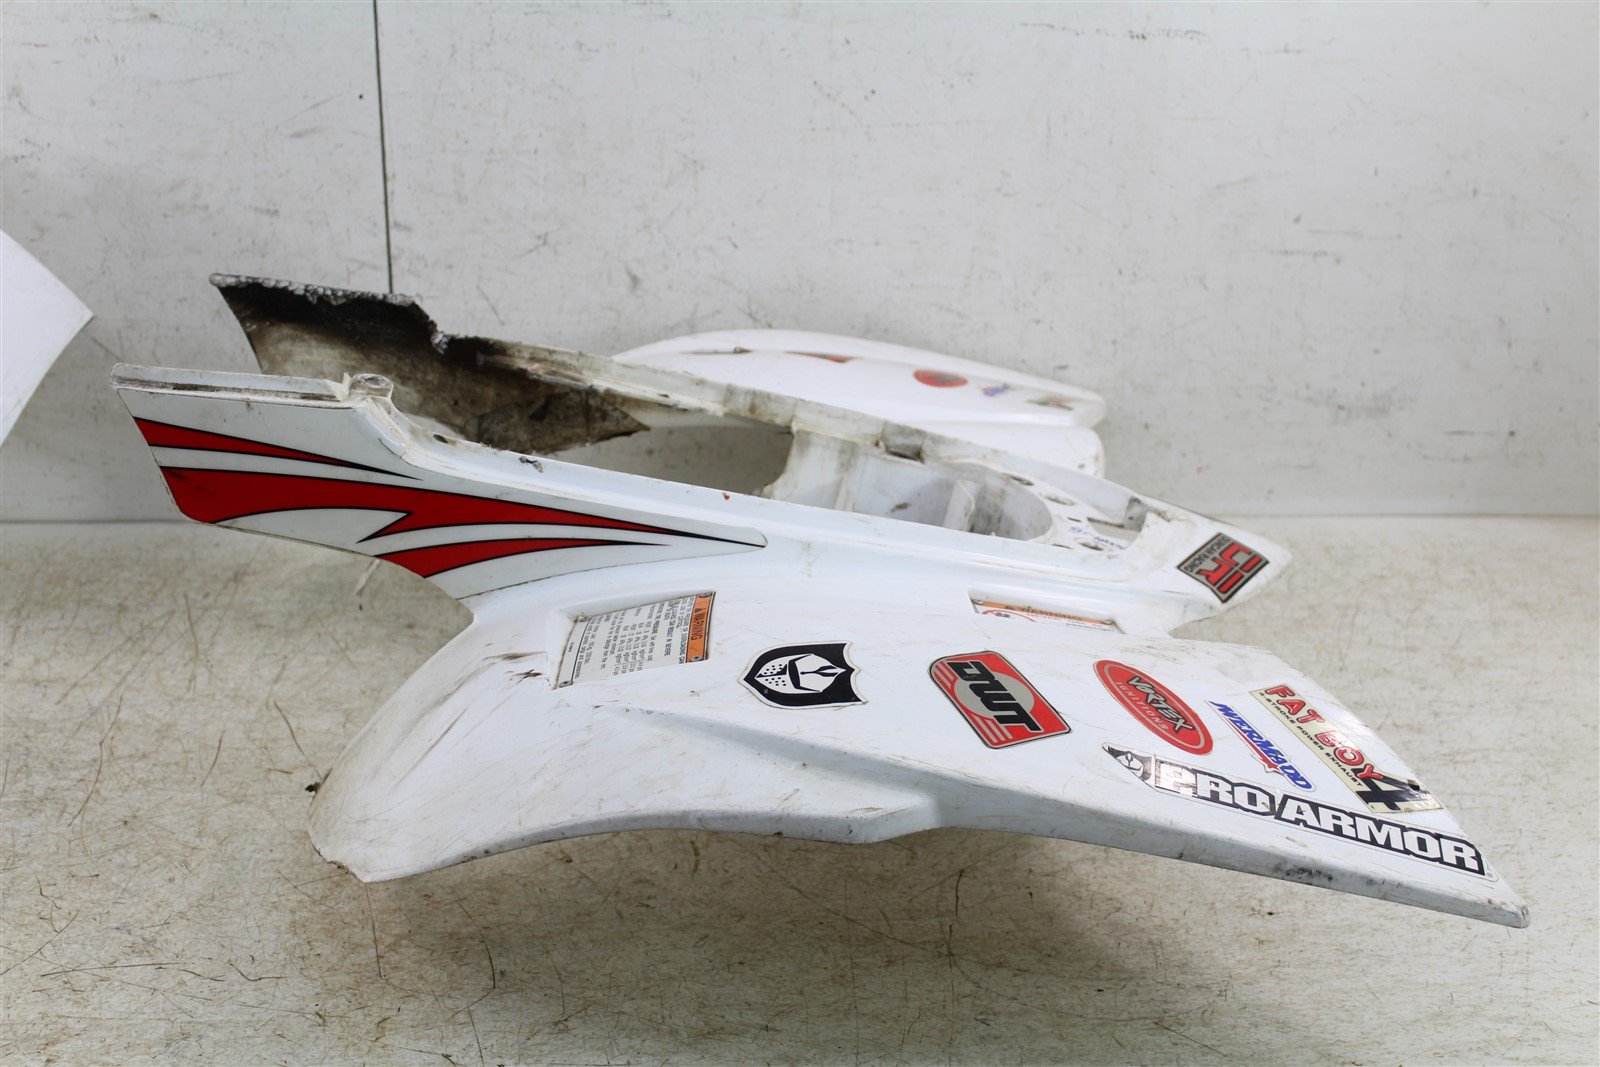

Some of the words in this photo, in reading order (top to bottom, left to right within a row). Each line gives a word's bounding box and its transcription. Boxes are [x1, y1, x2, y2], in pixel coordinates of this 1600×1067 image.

[690, 613, 704, 640] WARNING
[947, 661, 1043, 731] DWT
[1115, 681, 1169, 731] IGNITIONS
[1127, 675, 1196, 733] VORTEX
[1265, 684, 1326, 724] FAT
[1314, 730, 1384, 780] BOY
[1296, 725, 1325, 751] POWER
[1324, 752, 1364, 787] EXHAUST
[1157, 760, 1271, 813] PRO
[1285, 799, 1480, 871] ARMOR
